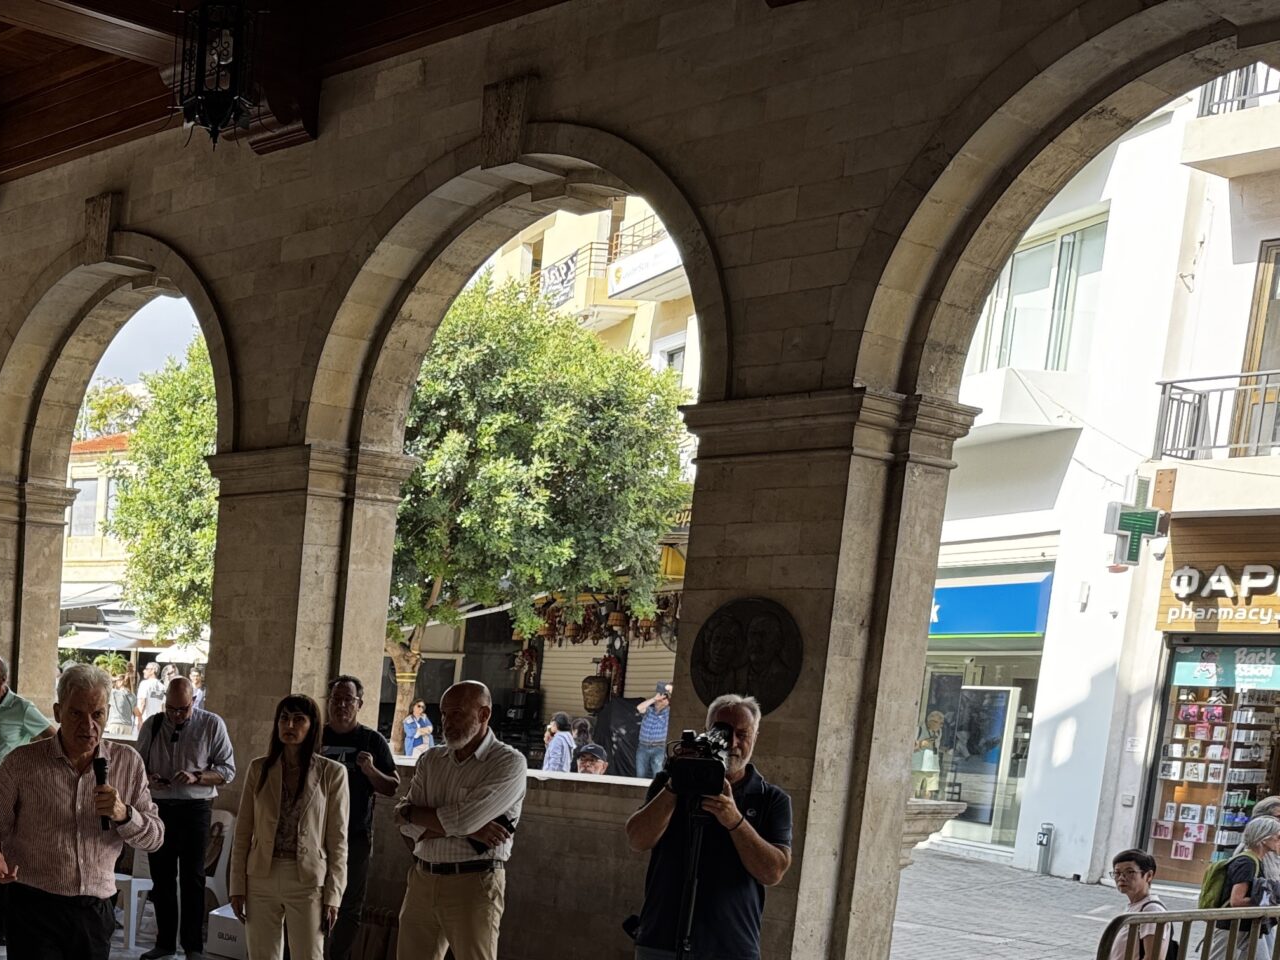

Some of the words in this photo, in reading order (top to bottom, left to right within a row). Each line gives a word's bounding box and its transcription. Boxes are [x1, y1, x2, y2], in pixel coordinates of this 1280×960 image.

[1170, 564, 1280, 598] ΦΑΡ
[1167, 601, 1273, 625] pharmacy
[1234, 647, 1277, 665] Back
